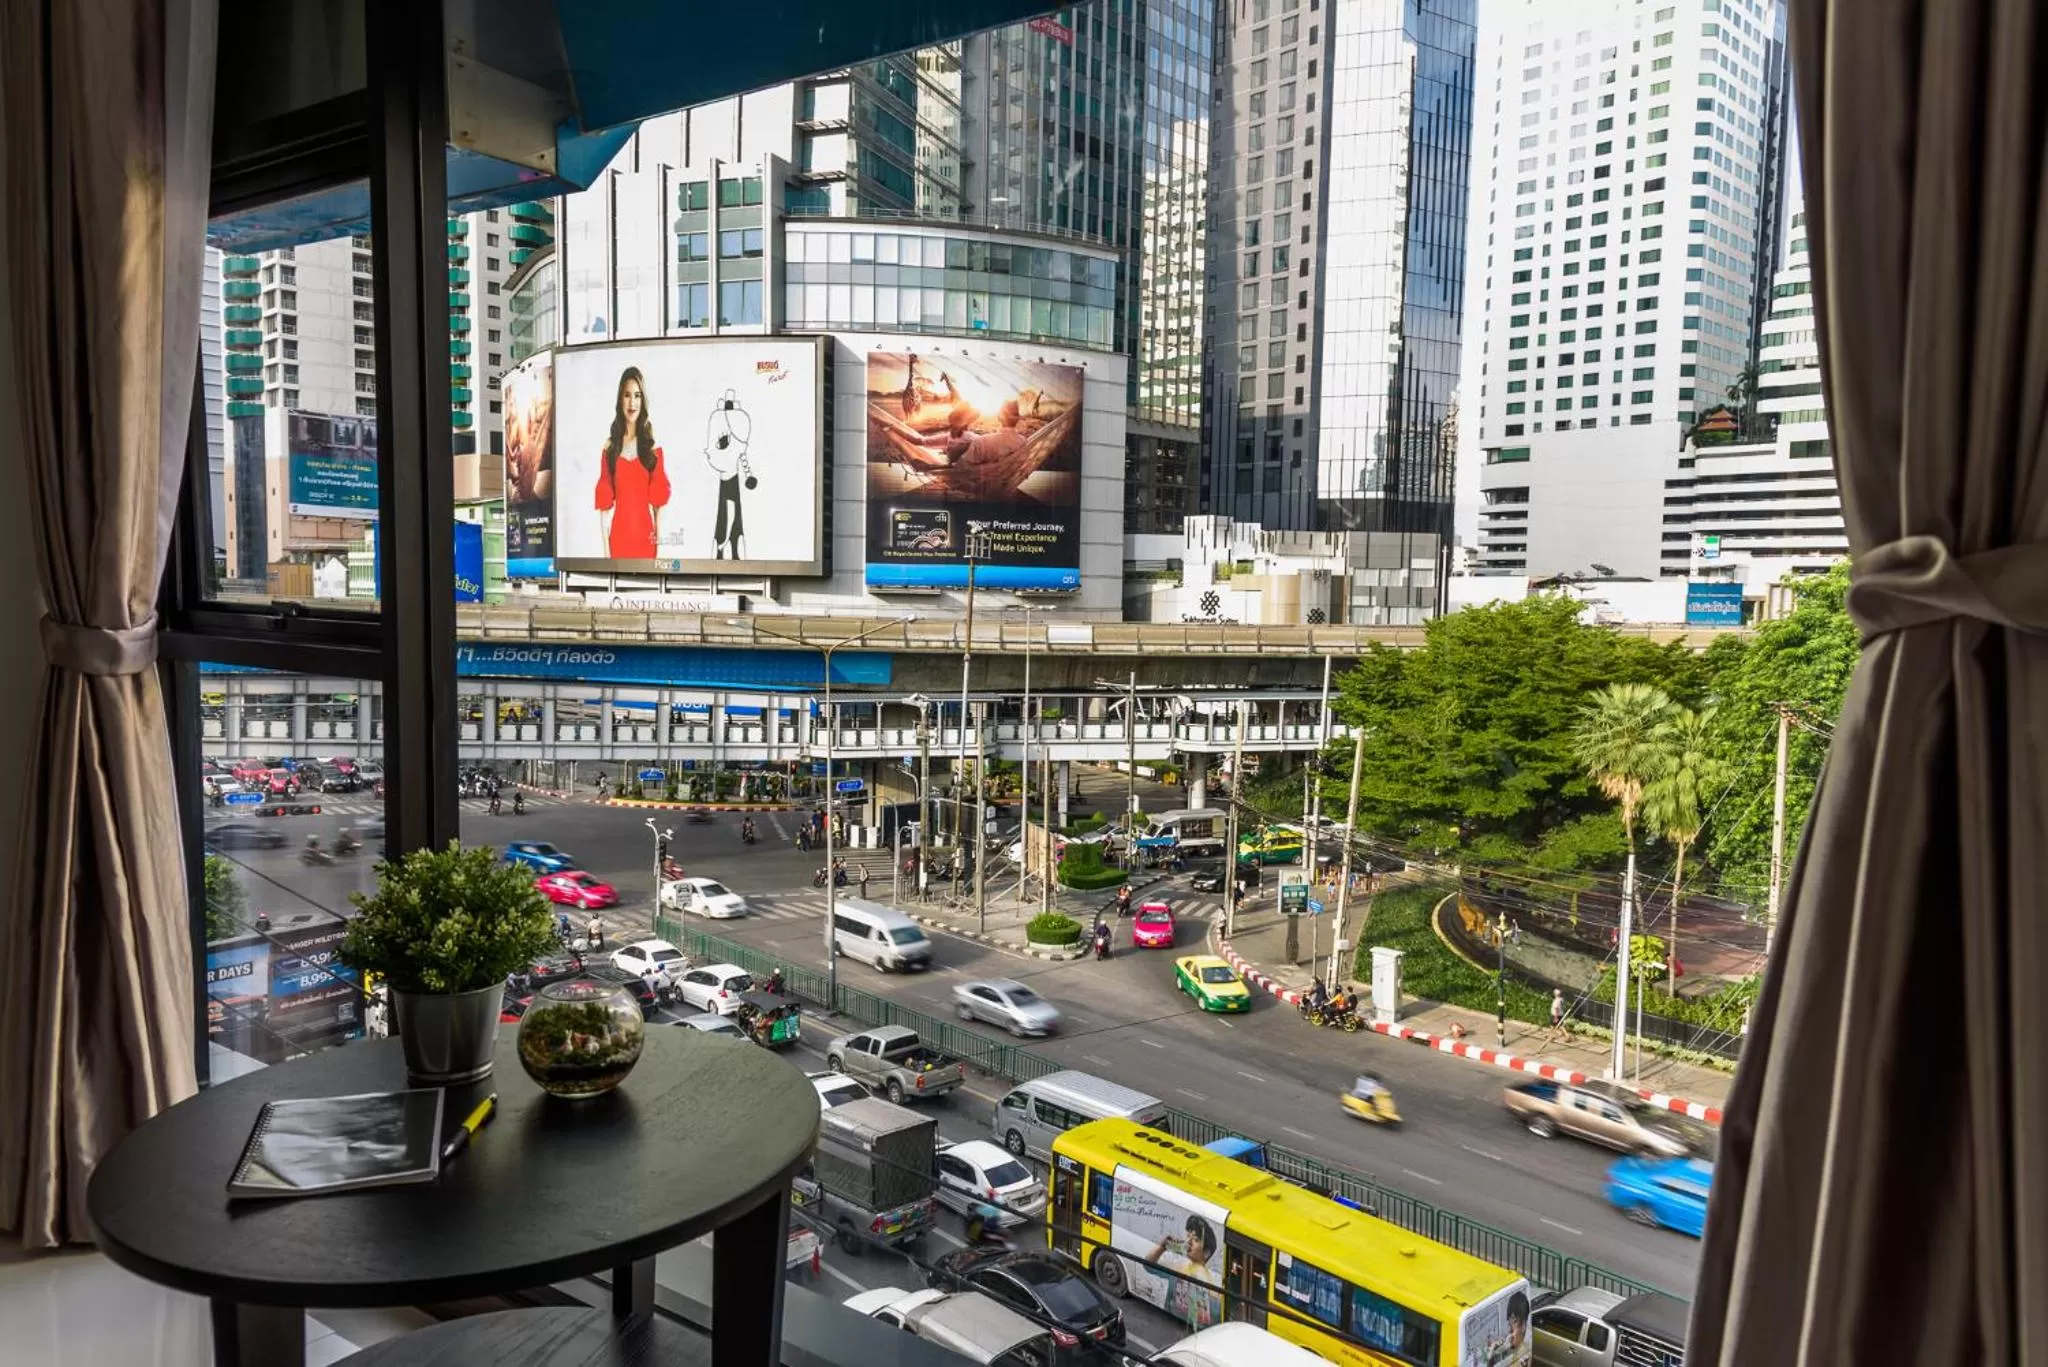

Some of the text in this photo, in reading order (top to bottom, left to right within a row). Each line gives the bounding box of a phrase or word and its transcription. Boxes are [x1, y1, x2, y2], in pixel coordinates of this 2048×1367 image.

[993, 520, 1031, 530] Preferred
[991, 531, 1013, 540] Travel
[1015, 533, 1057, 543] Experience
[993, 543, 1014, 552] Made
[218, 963, 251, 979] DAYS
